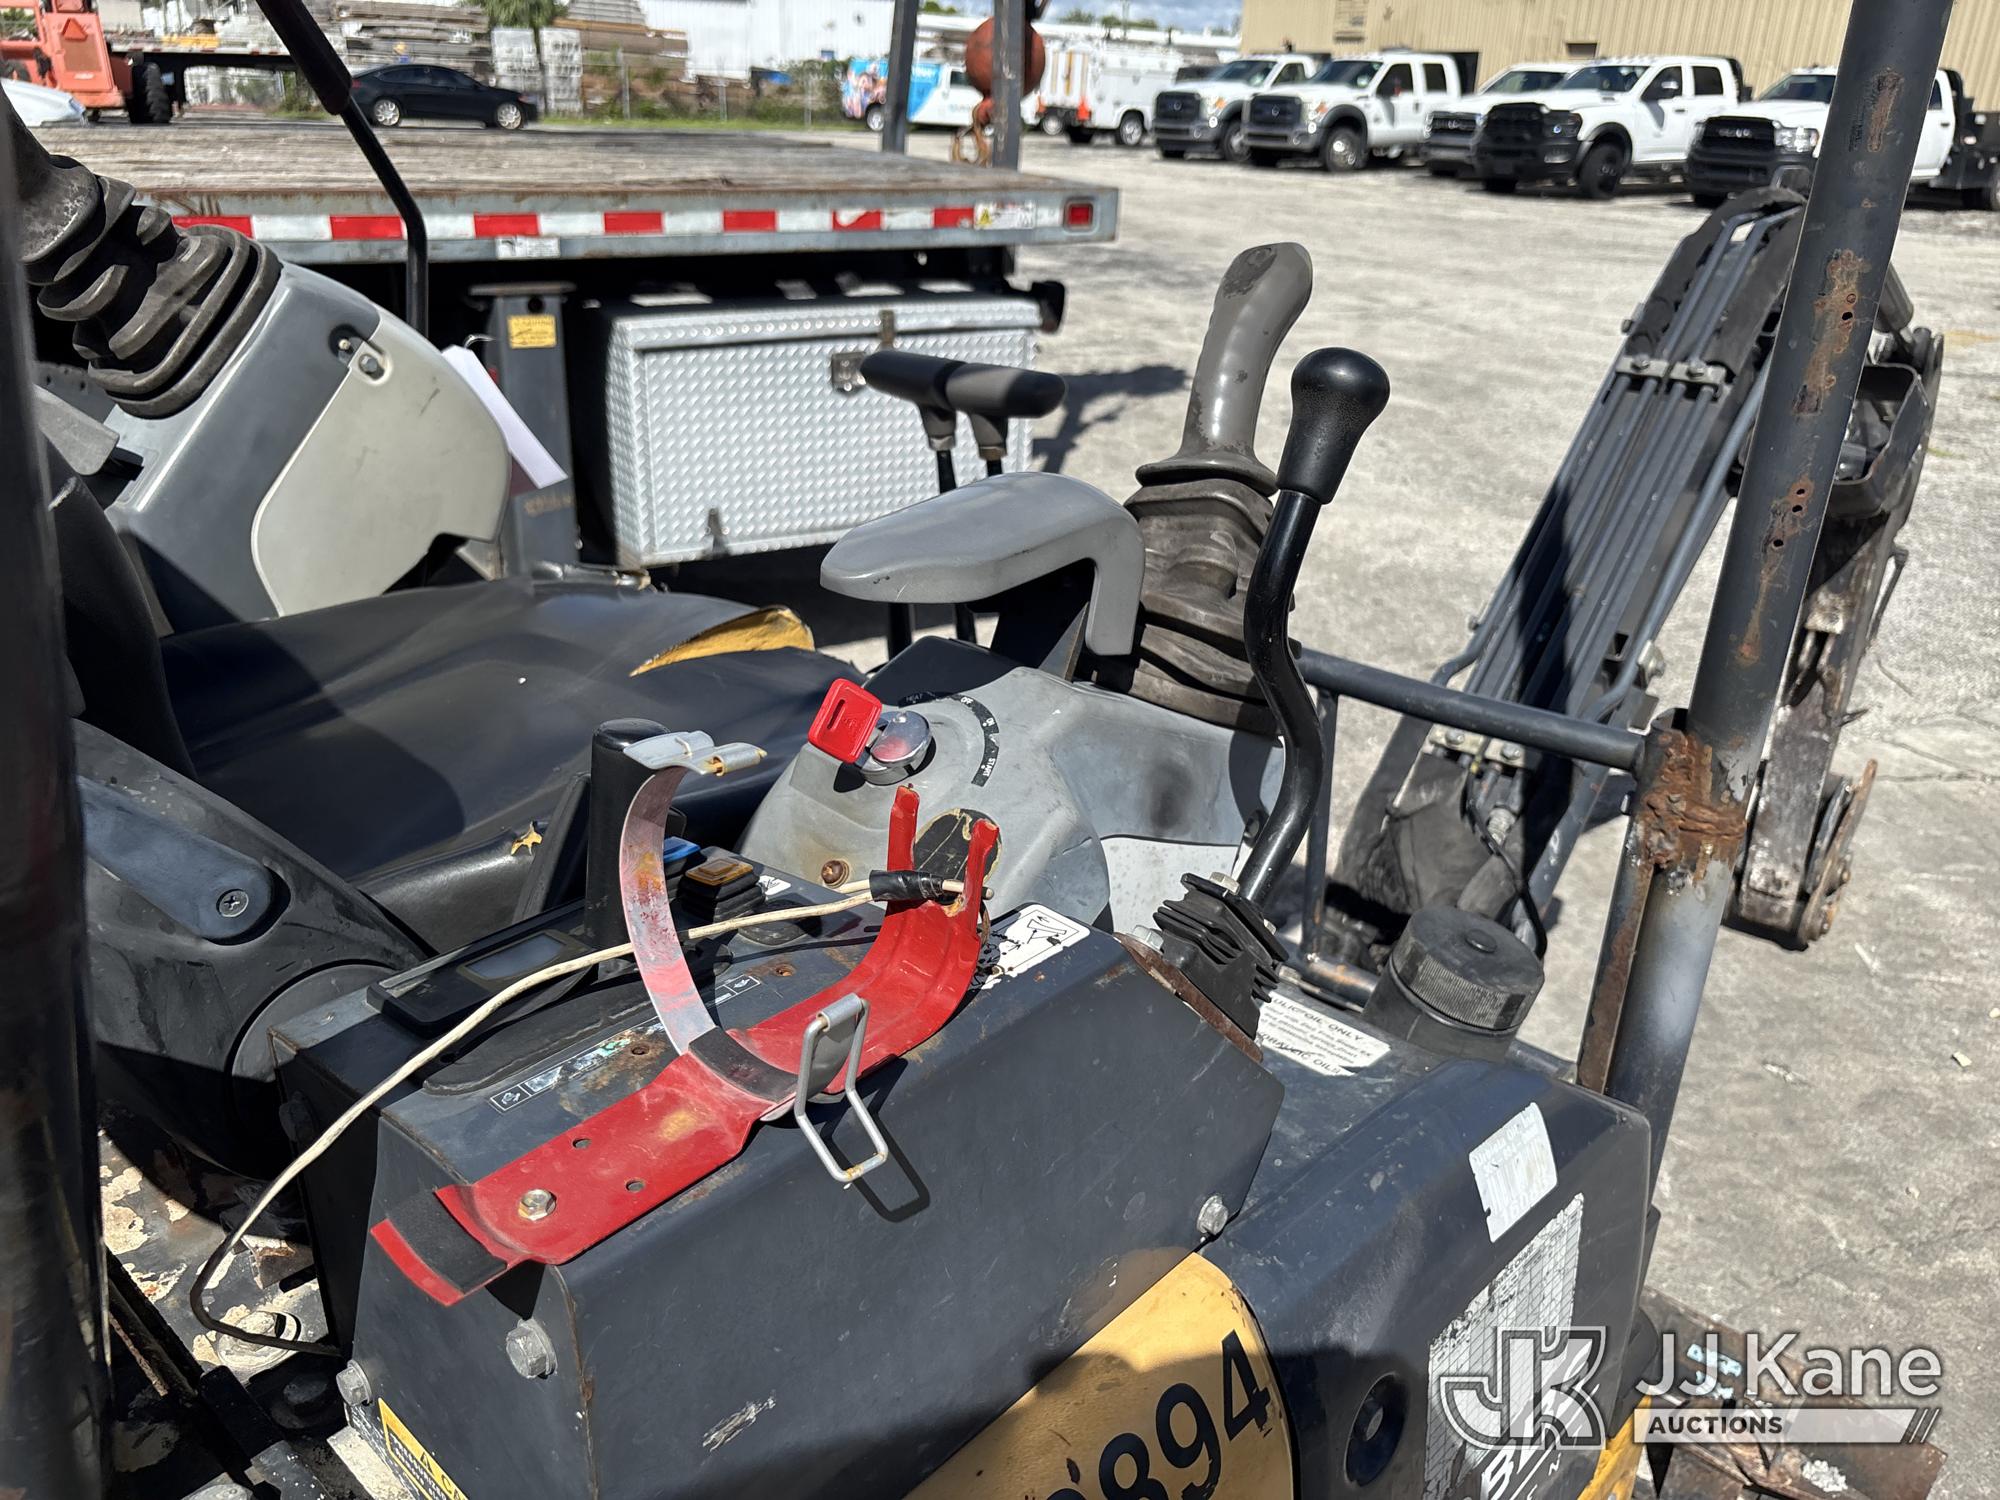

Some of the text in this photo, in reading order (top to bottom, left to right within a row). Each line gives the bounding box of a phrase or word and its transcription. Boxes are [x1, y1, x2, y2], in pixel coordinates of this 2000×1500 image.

[960, 696, 974, 705] OFF
[983, 758, 996, 777] START
[1328, 1023, 1364, 1041] ONLY
[1046, 1328, 1272, 1500] 894
